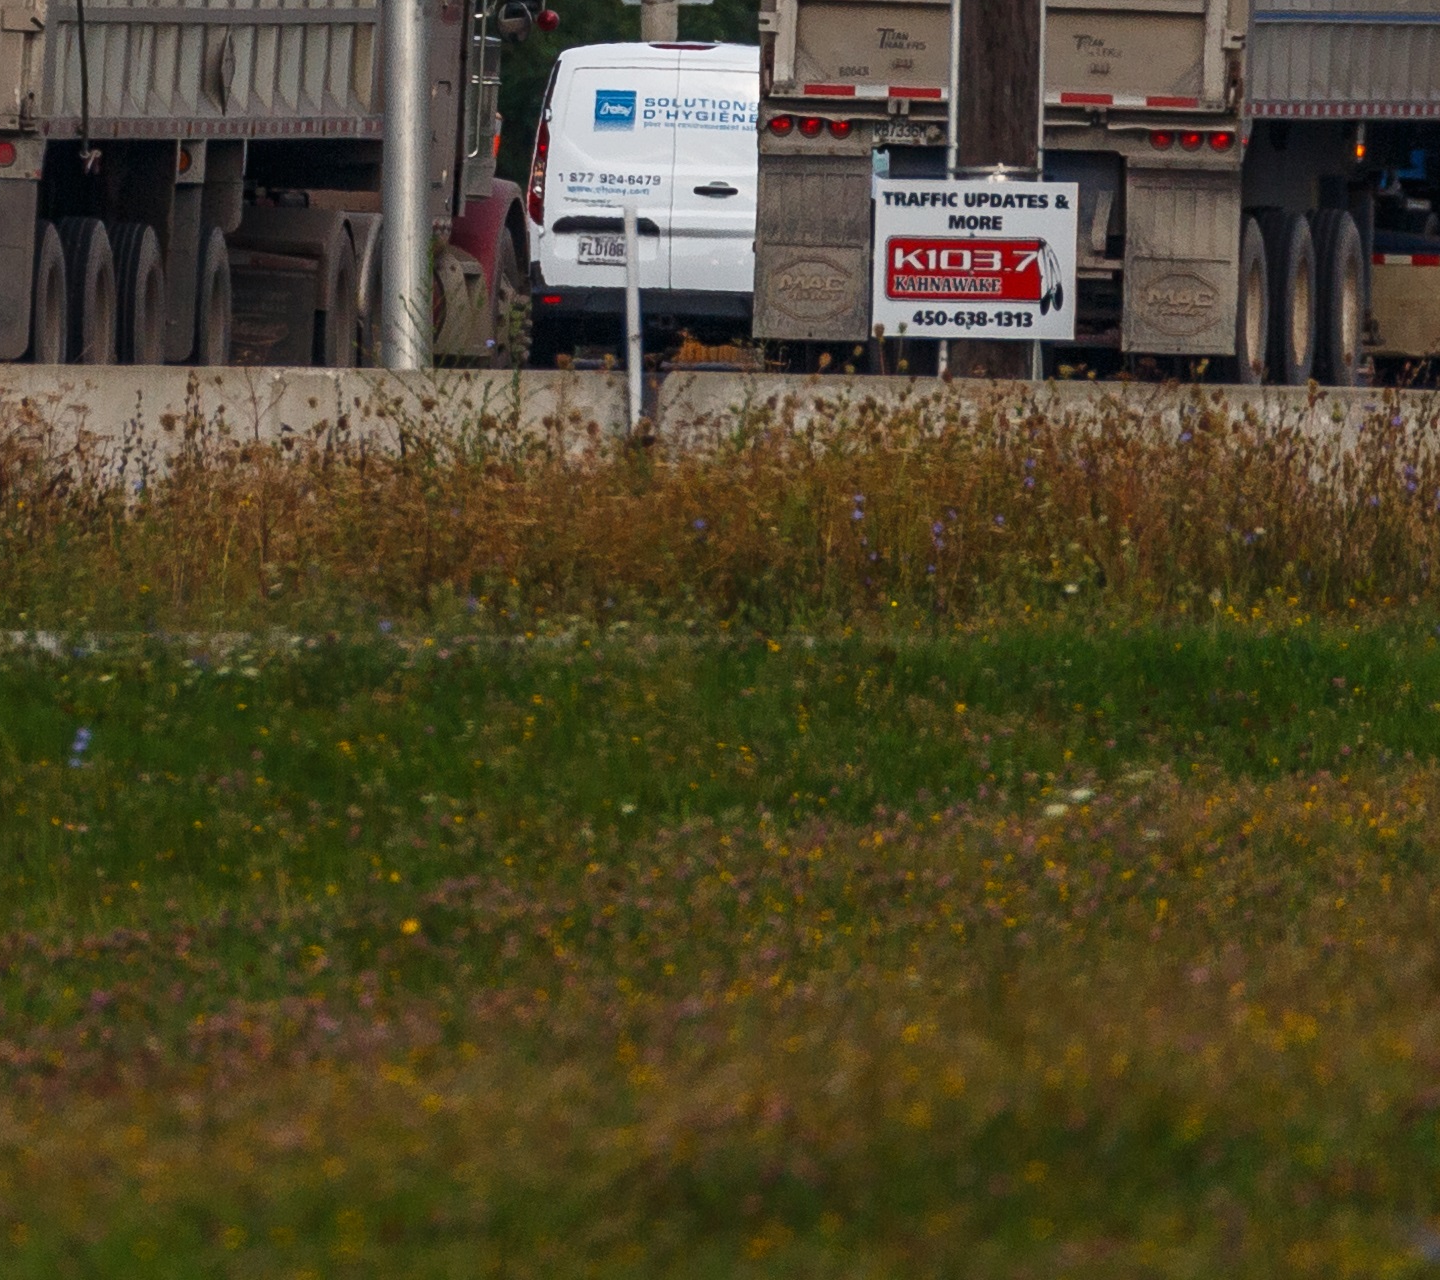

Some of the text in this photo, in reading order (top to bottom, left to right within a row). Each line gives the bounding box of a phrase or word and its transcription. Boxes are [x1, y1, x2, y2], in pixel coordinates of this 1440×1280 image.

[569, 172, 595, 183] 877
[882, 191, 1070, 210] TRAFFIC UPDATES &
[947, 215, 1003, 231] MORE
[893, 247, 1039, 272] K103.7
[893, 274, 1003, 294] KAHNAWAKE
[911, 310, 1034, 328] 450-638-1313
